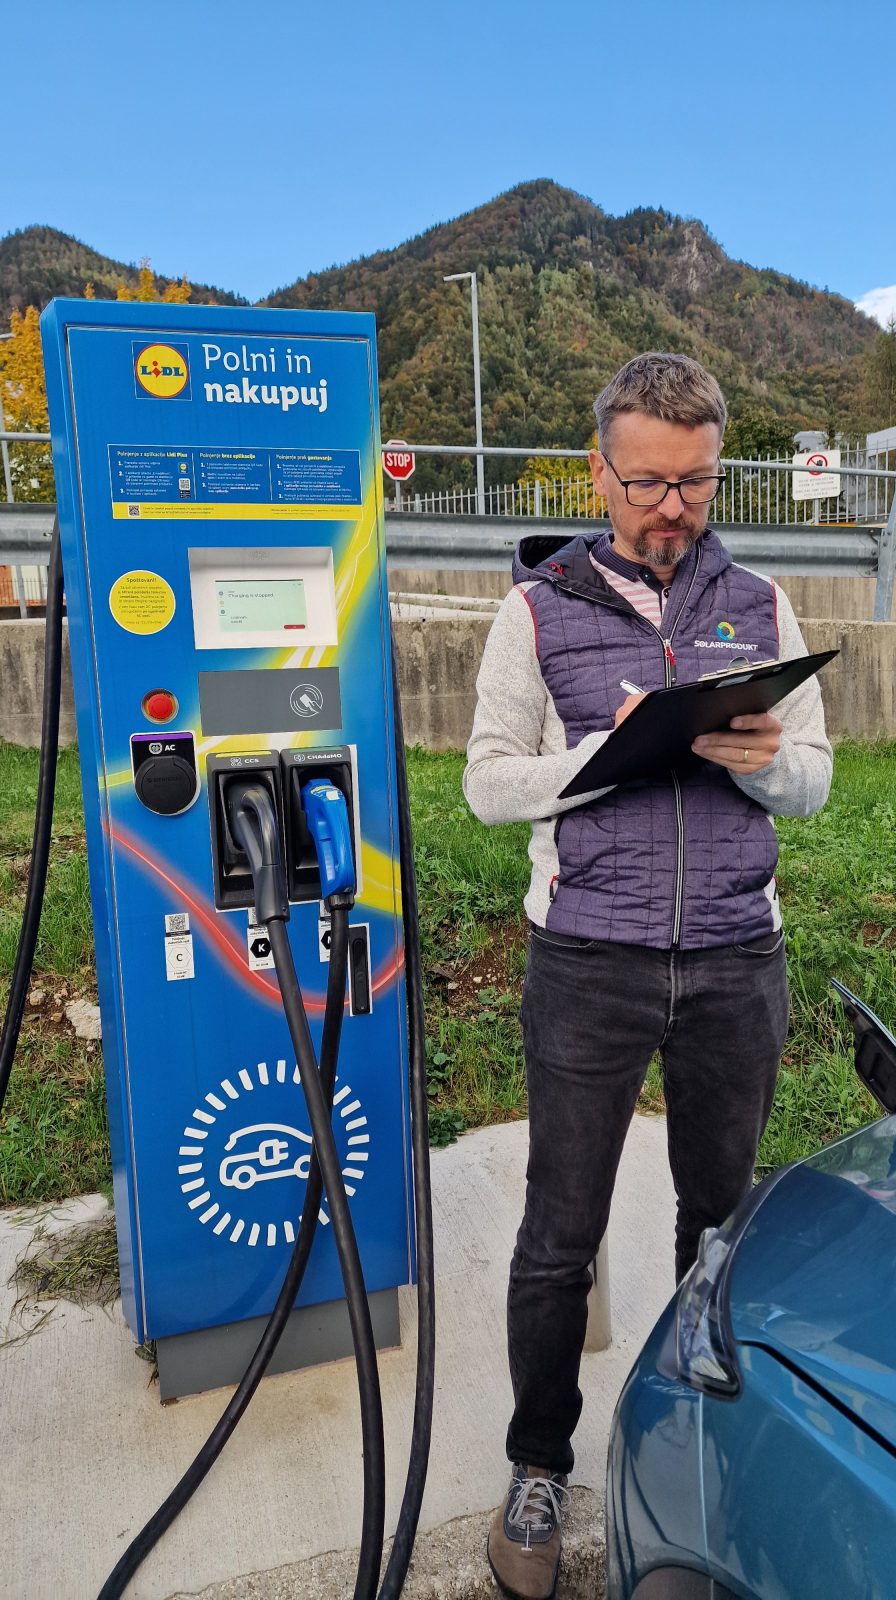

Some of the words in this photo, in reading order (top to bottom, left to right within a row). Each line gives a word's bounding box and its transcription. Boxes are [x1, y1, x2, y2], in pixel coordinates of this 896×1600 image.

[202, 343, 276, 373] Polni
[285, 348, 311, 374] in
[203, 377, 328, 413] nakupuj
[386, 452, 411, 467] STOP
[693, 640, 759, 652] SOLARPRODUKT
[258, 943, 266, 953] K
[176, 953, 183, 962] C
